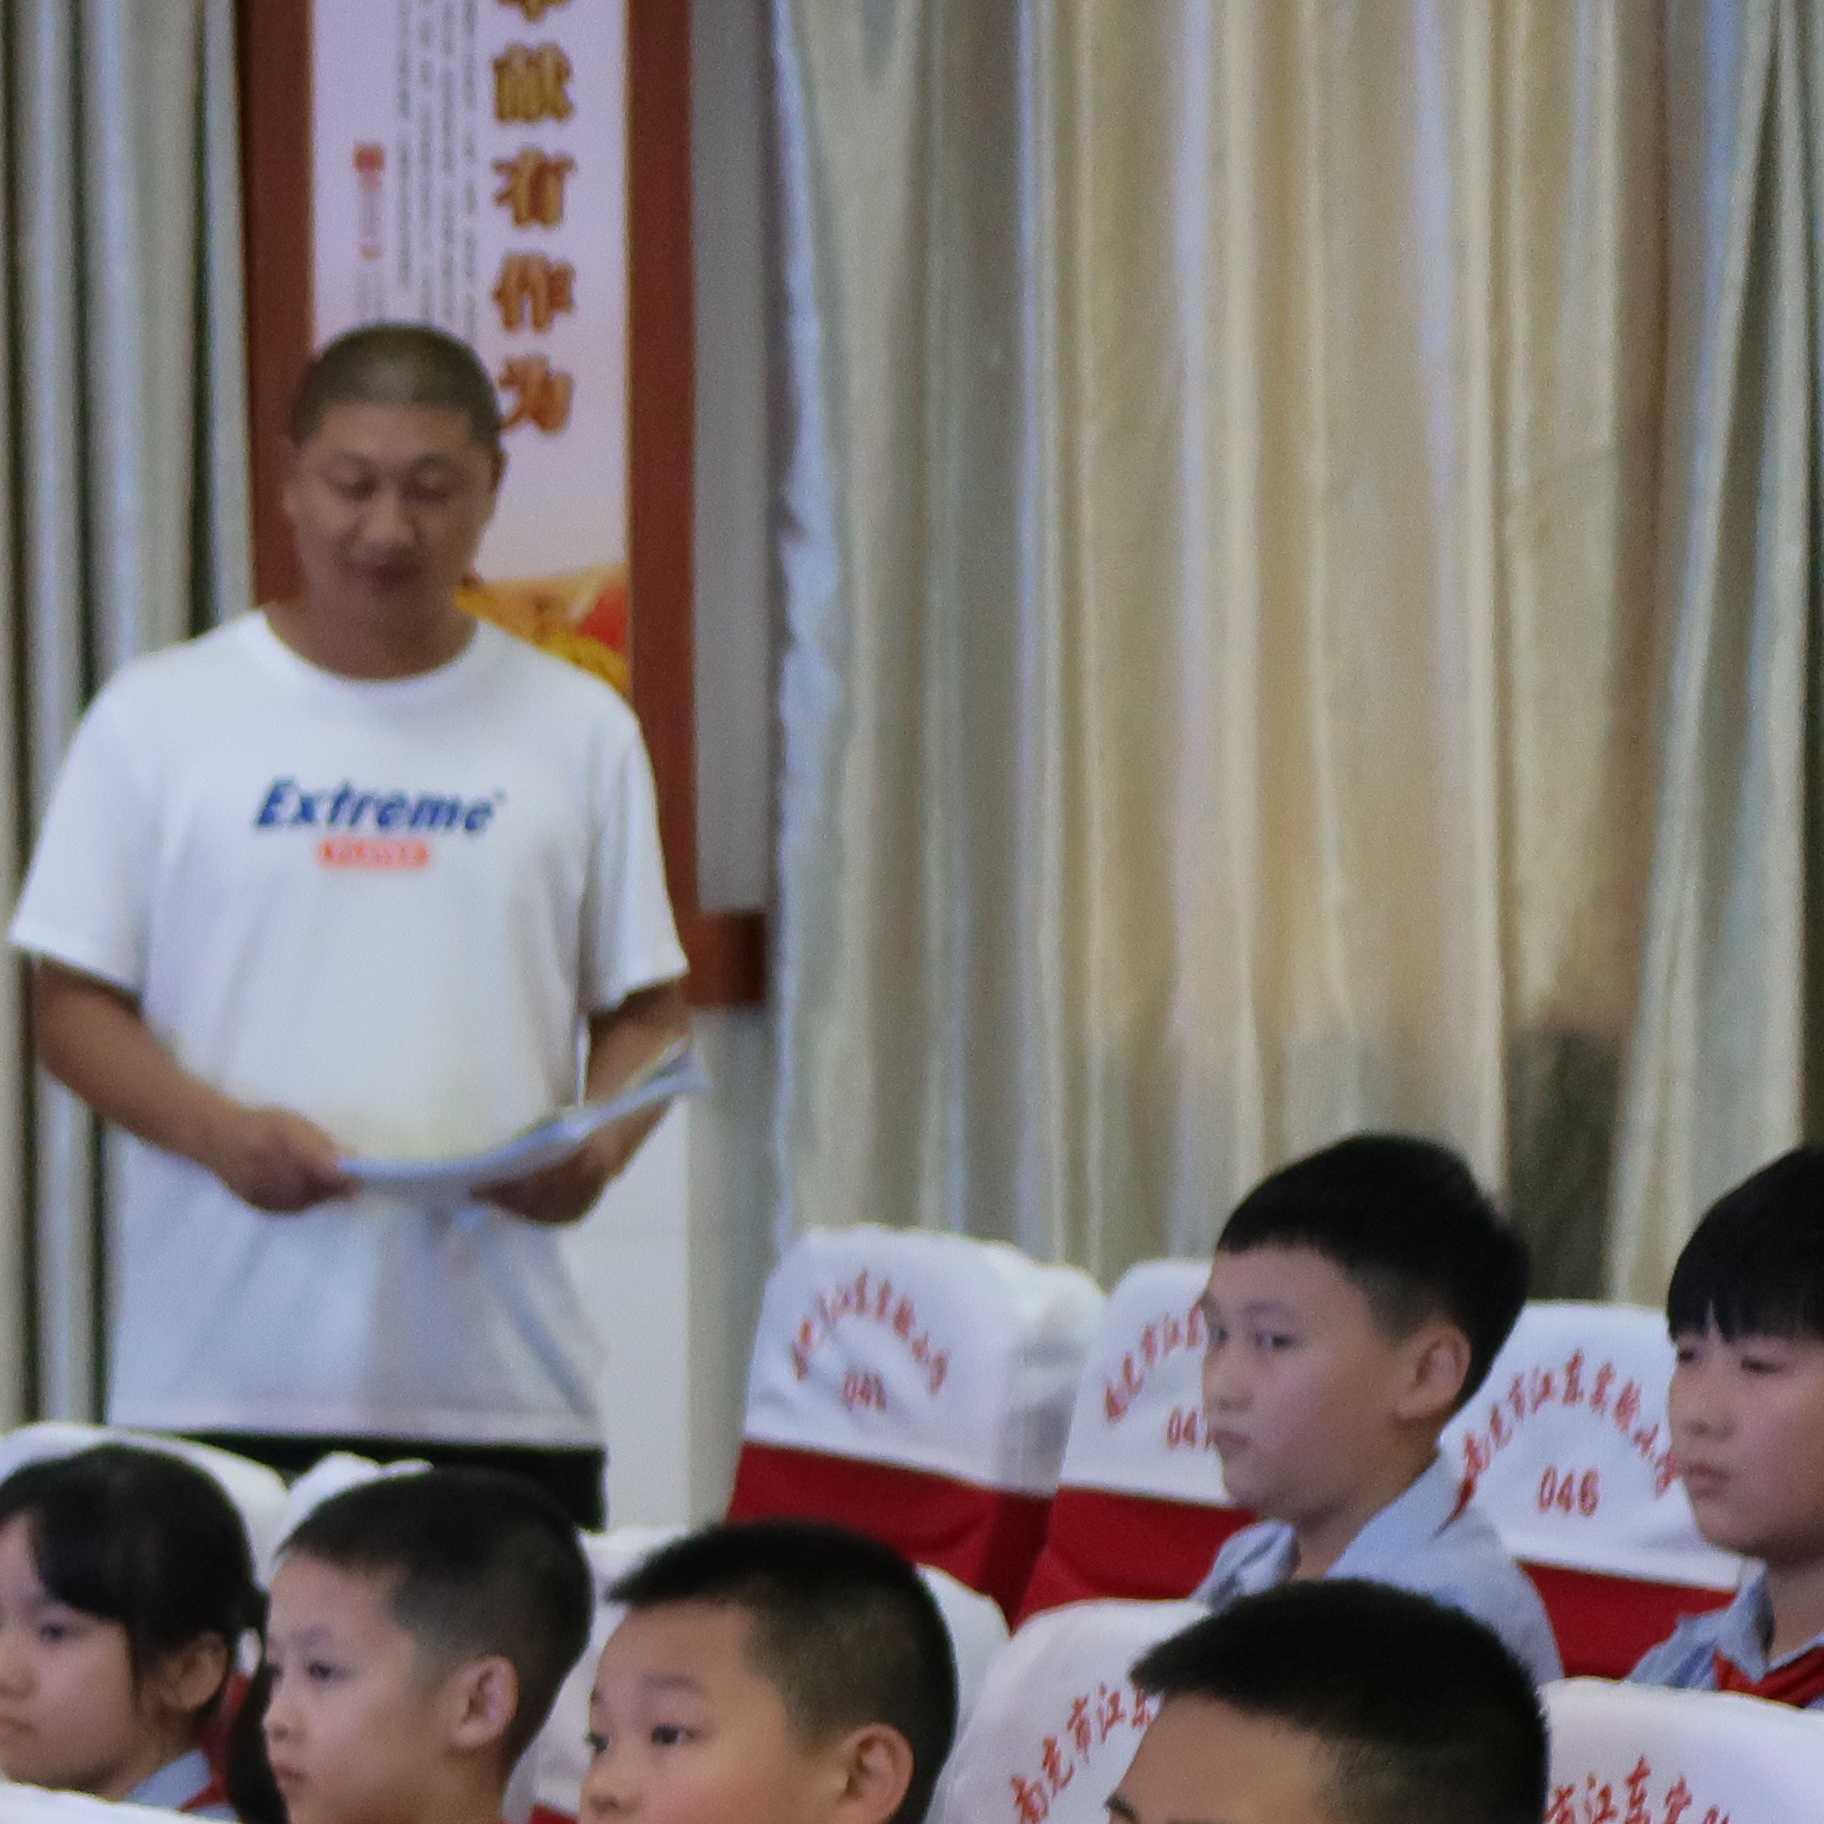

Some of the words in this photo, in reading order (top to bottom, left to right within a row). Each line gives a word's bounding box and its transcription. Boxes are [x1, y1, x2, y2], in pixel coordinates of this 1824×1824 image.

[491, 0, 578, 435] 献有作为
[255, 775, 494, 834] Extreme
[1463, 1348, 1677, 1498] 南充市江东实验小学
[1538, 1464, 1600, 1517] 046
